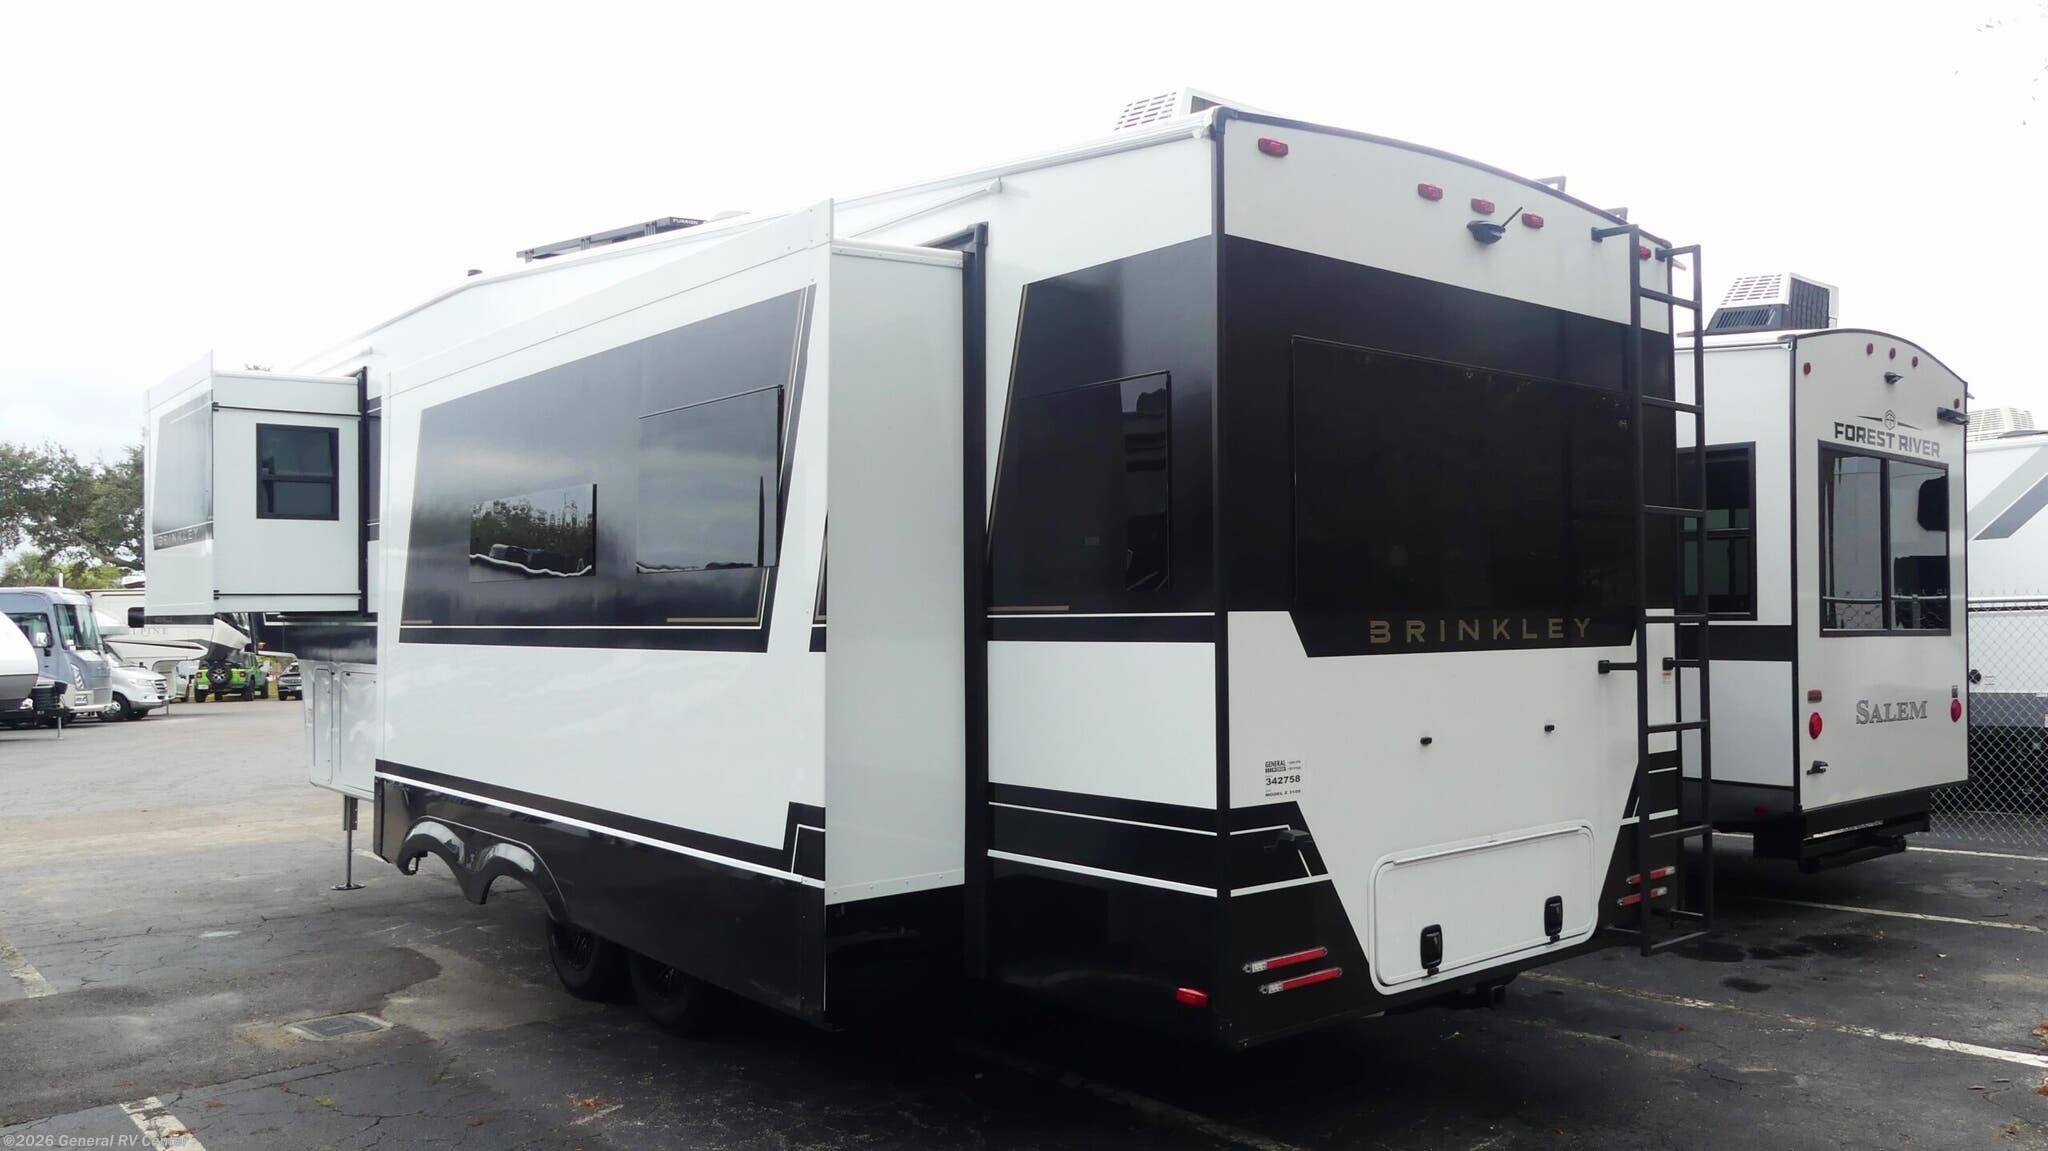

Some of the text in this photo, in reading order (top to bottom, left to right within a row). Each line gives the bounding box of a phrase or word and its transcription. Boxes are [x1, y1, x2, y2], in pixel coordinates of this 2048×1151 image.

[1834, 421, 1940, 458] FOREST RIVER
[1369, 617, 1591, 644] BRINKLEY
[1265, 775, 1301, 786] 342758
